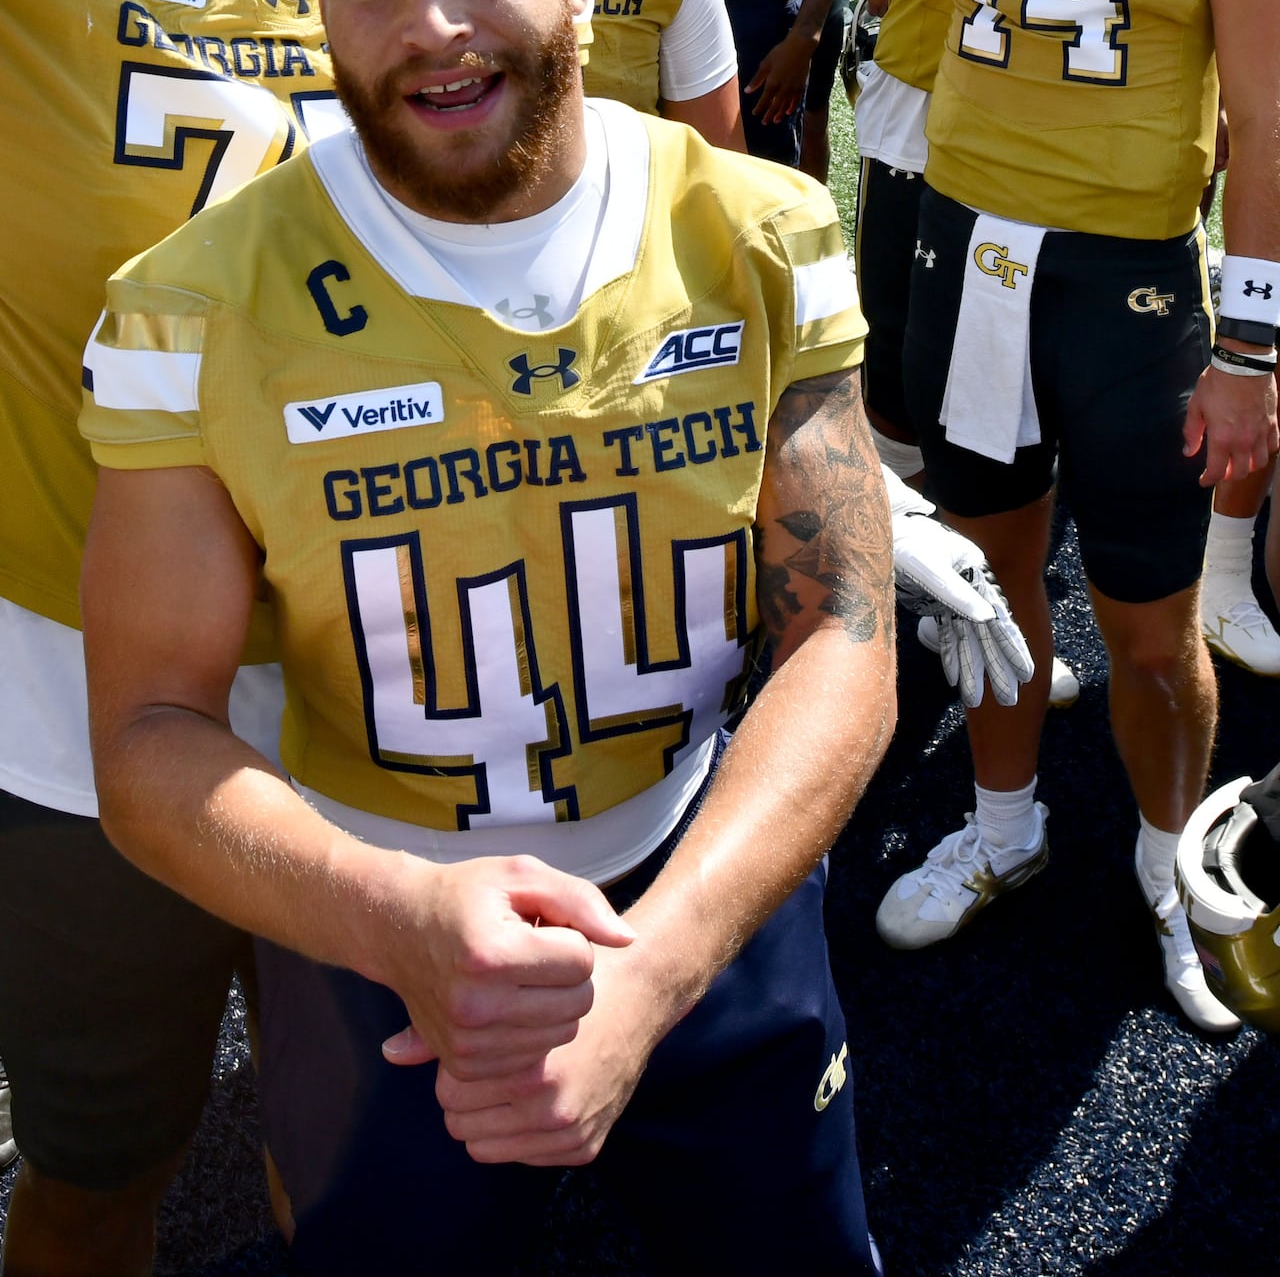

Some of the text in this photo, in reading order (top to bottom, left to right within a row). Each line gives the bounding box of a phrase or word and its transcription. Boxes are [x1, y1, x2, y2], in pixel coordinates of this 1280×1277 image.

[116, 0, 316, 79] GEORGIA
[305, 259, 369, 337] C
[972, 241, 1029, 291] GT
[1125, 285, 1176, 318] GT
[650, 325, 743, 374] ACC
[322, 401, 764, 522] GEORGIA TECH
[339, 490, 760, 832] 44
